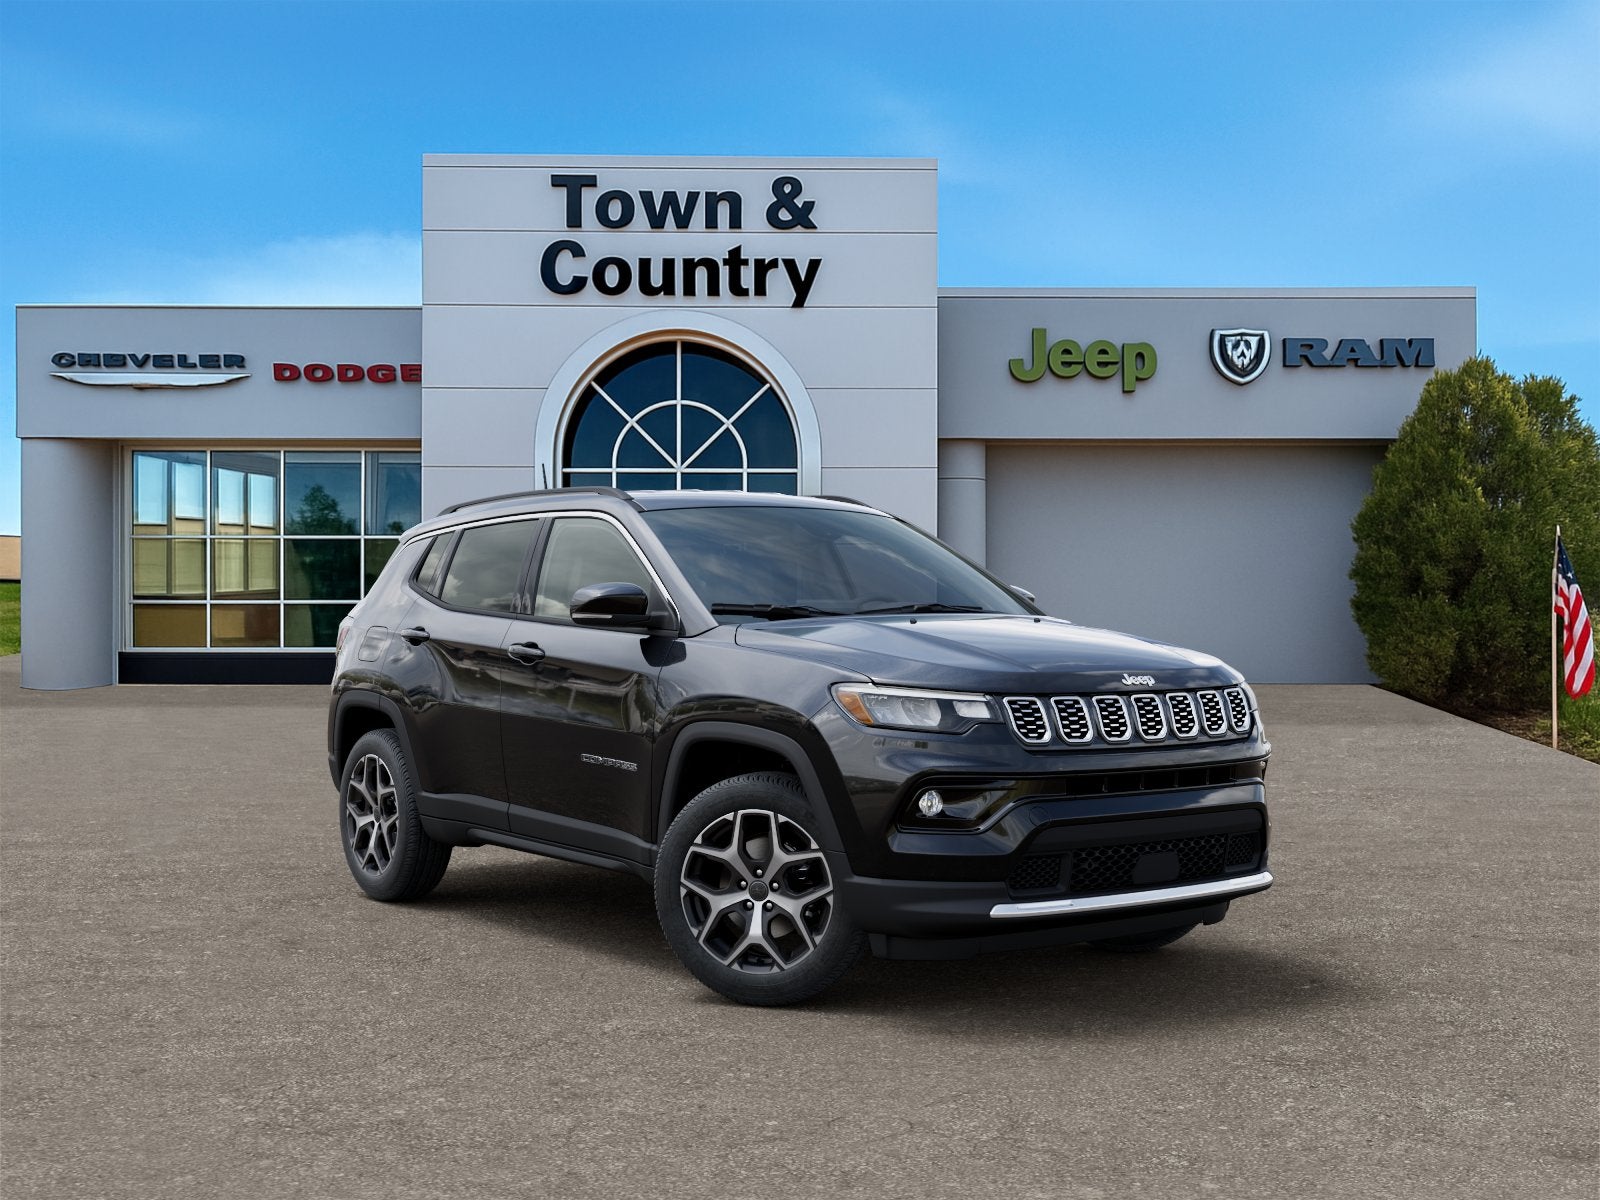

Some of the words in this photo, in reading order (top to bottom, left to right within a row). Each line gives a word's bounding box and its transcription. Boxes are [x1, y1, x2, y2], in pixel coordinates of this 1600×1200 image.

[550, 174, 742, 229] Town
[766, 176, 818, 230] &
[540, 239, 822, 308] Country
[273, 363, 422, 384] DODGE
[1009, 328, 1158, 393] Jeep
[1282, 337, 1436, 368] RAM
[1121, 673, 1156, 687] Jeep
